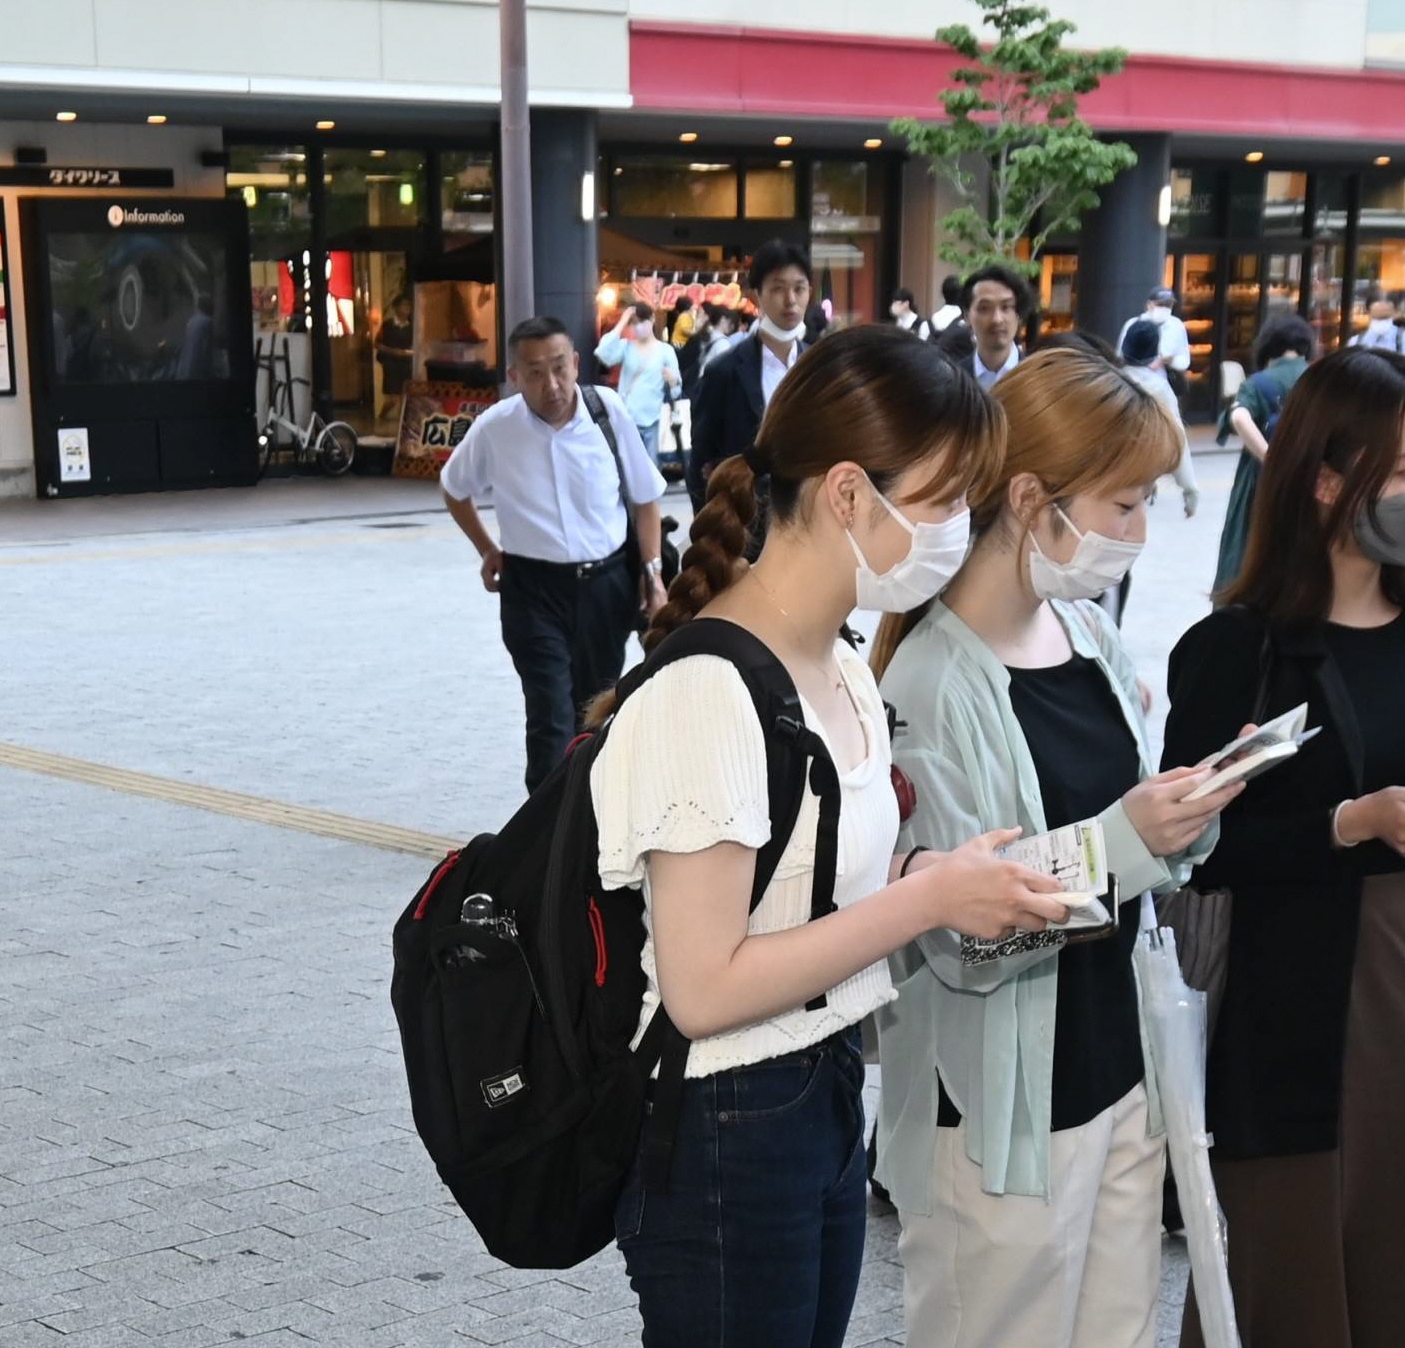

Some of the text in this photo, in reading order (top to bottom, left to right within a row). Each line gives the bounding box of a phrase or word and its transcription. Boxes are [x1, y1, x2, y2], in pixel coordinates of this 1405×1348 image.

[49, 169, 120, 185] ダイワリース
[124, 207, 185, 223] Information
